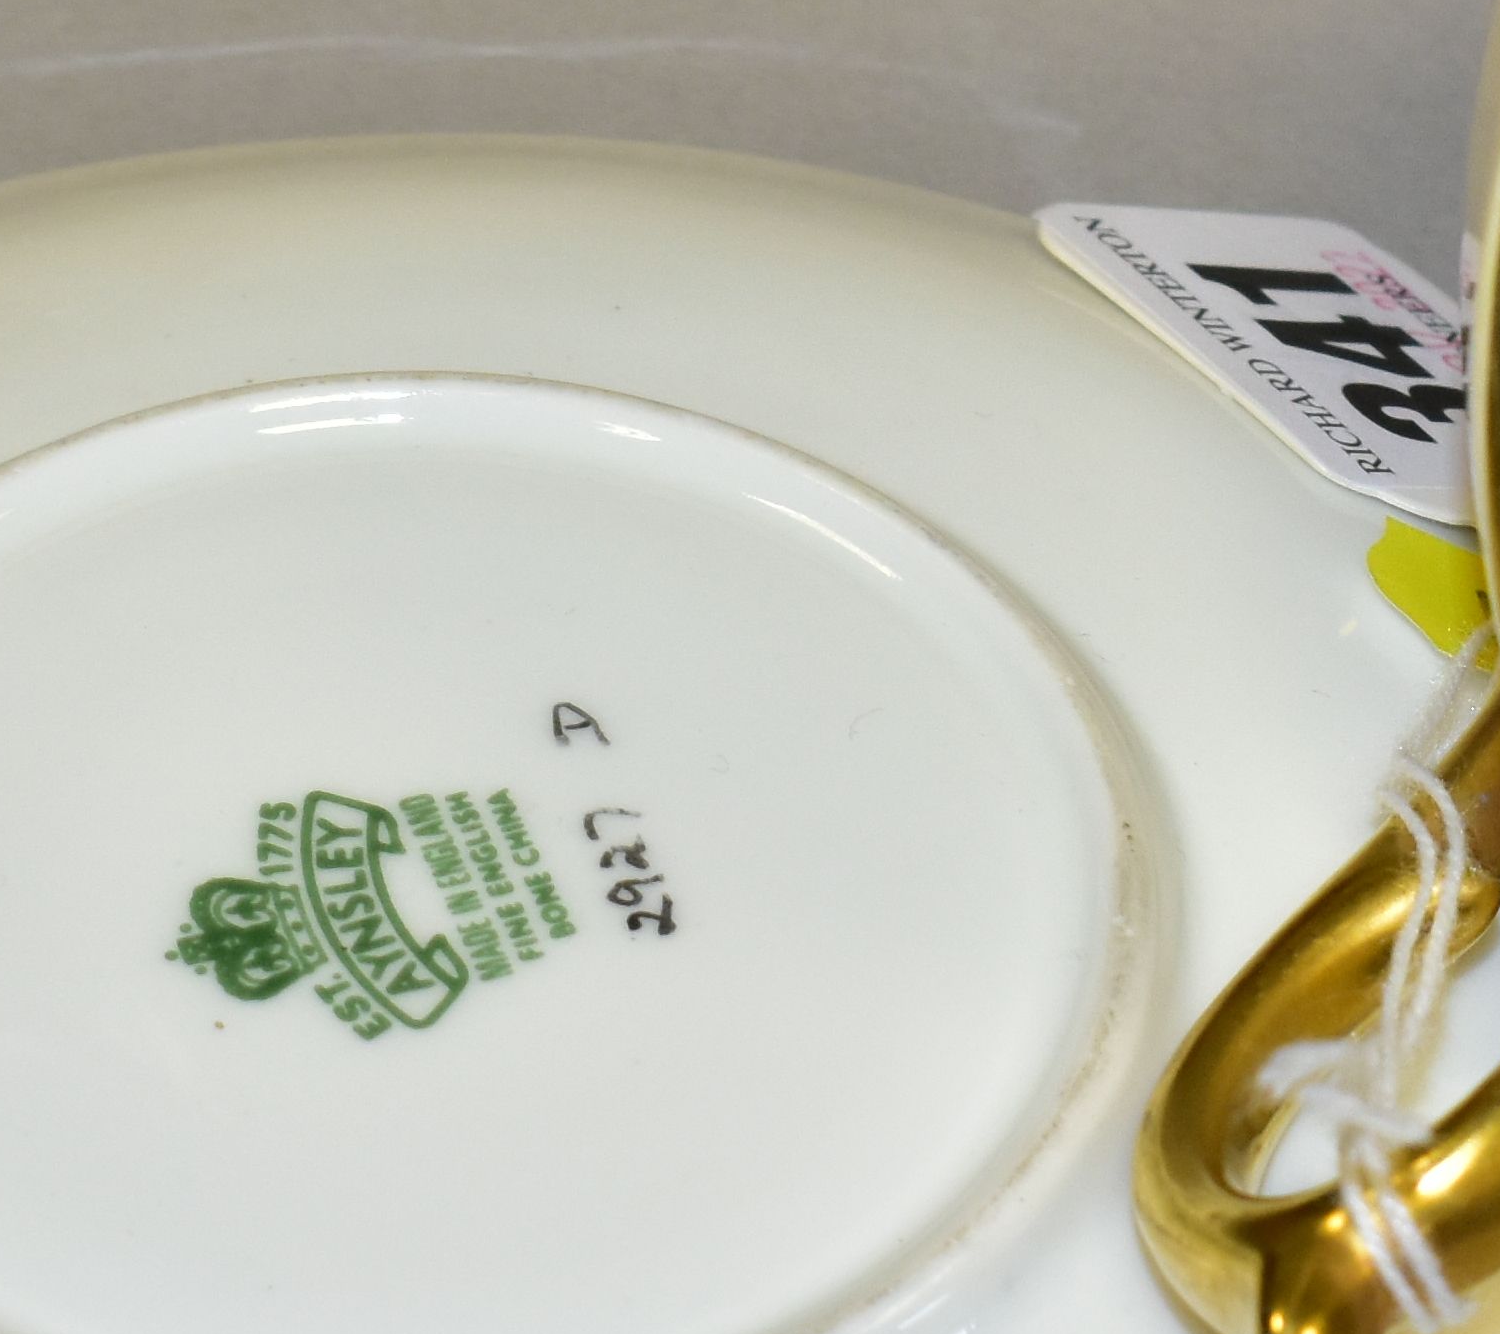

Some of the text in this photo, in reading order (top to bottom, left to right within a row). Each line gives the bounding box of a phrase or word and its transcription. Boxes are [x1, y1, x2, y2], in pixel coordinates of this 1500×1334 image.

[1074, 215, 1251, 351] WINTERTON
[1186, 263, 1467, 443] 341
[1248, 358, 1395, 476] RICHARD
[256, 801, 297, 876] 1775
[316, 816, 435, 996] AYNSLEY
[399, 792, 514, 982] MADE IN ENGLAND
[445, 790, 544, 963] FINE ENGLISH
[487, 787, 577, 939] BONE CHINA
[583, 807, 678, 935] 2927
